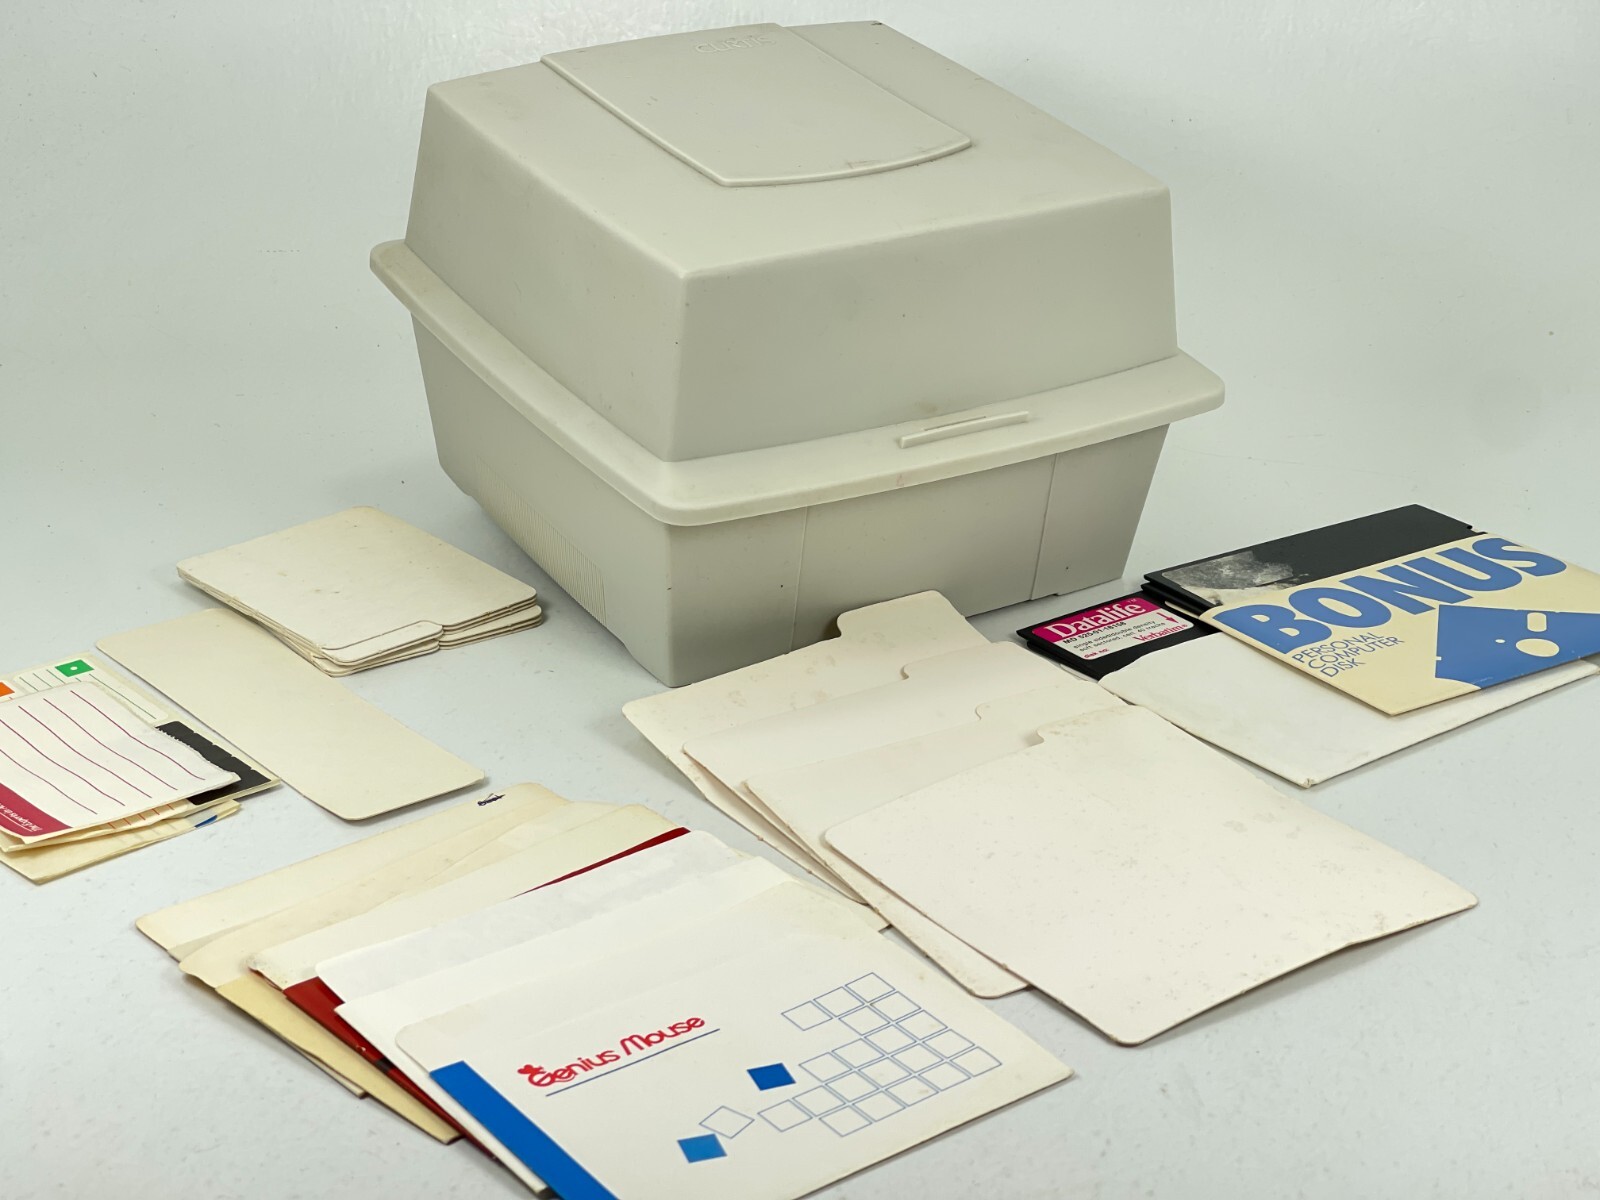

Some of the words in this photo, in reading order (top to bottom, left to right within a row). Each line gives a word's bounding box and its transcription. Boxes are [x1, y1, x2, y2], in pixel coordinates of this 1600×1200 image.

[1213, 537, 1567, 655] BONUS
[1045, 603, 1146, 638] Datalife
[1292, 632, 1384, 663] PERSONAL
[1308, 636, 1405, 669] COMPUTER
[1320, 658, 1366, 678] DISK
[527, 1050, 621, 1087] Genius
[620, 1017, 705, 1056] Mouse
